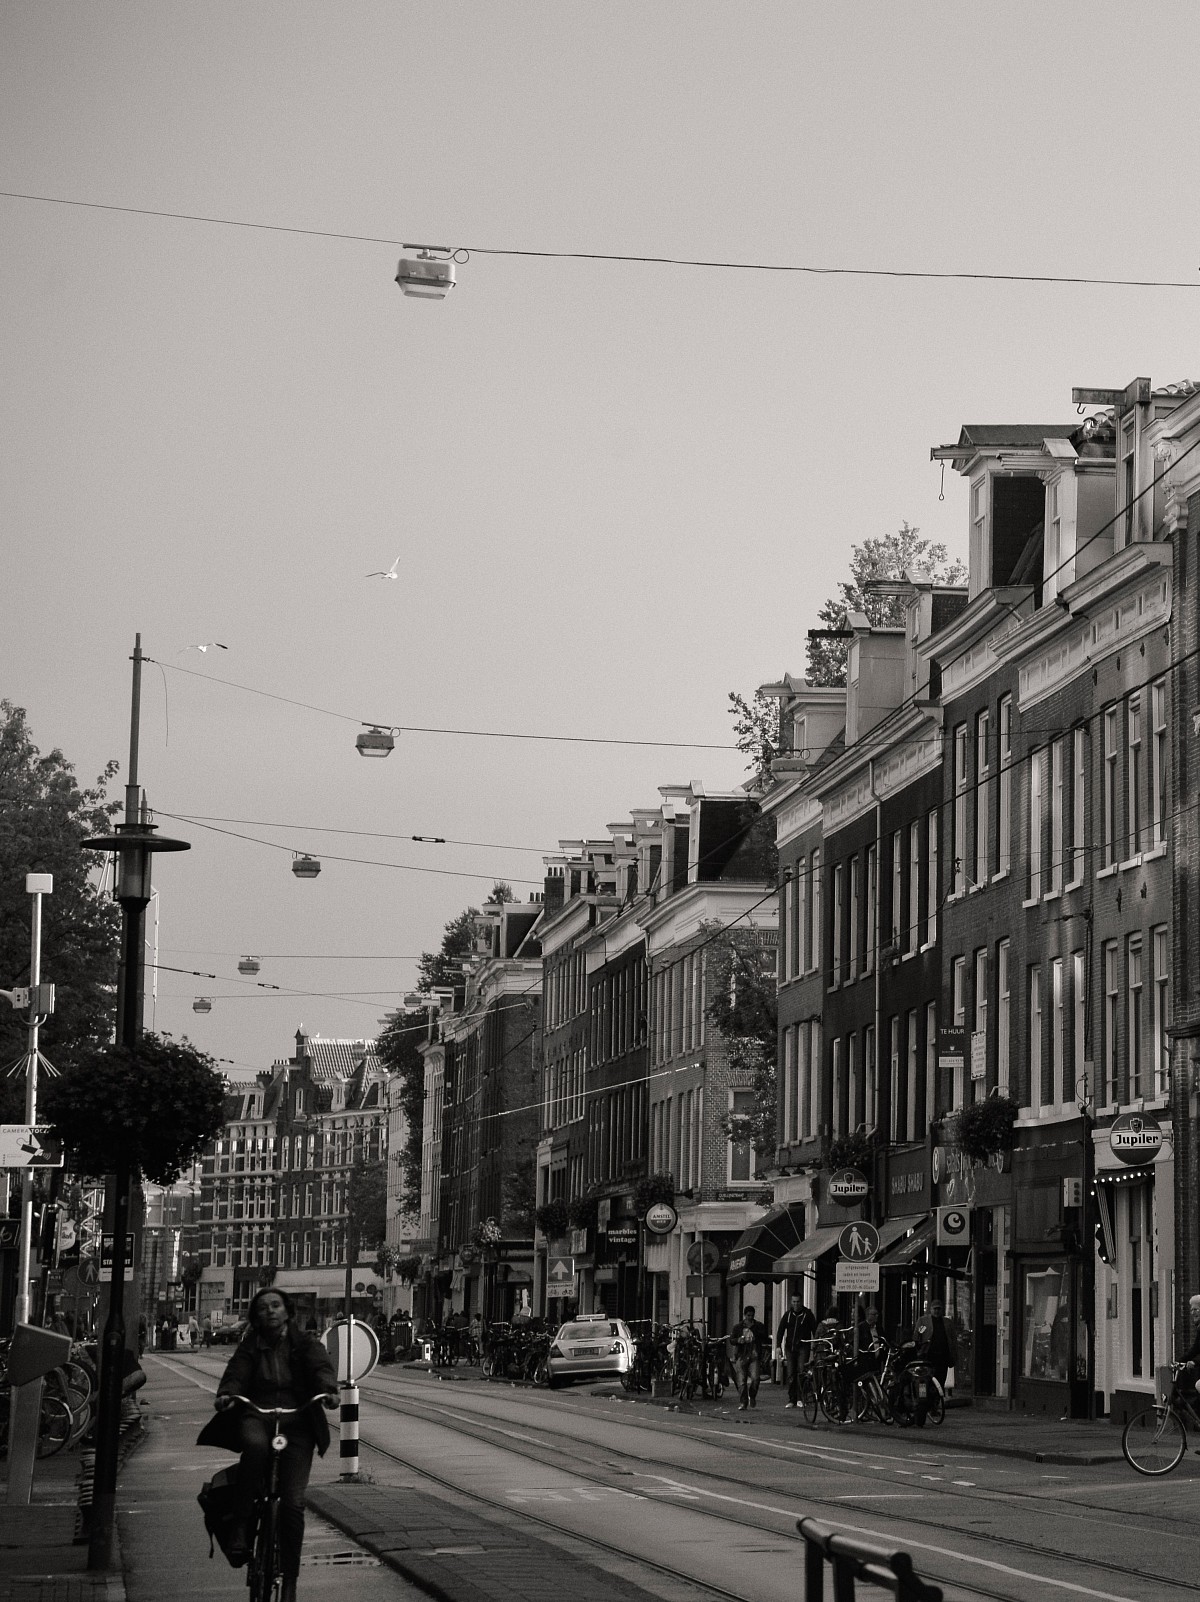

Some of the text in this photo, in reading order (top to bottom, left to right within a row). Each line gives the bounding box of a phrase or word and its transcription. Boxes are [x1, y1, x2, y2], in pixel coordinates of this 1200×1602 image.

[1116, 1134, 1159, 1146] Jupiler
[833, 1184, 866, 1194] Jupiler
[609, 1236, 636, 1244] vintage
